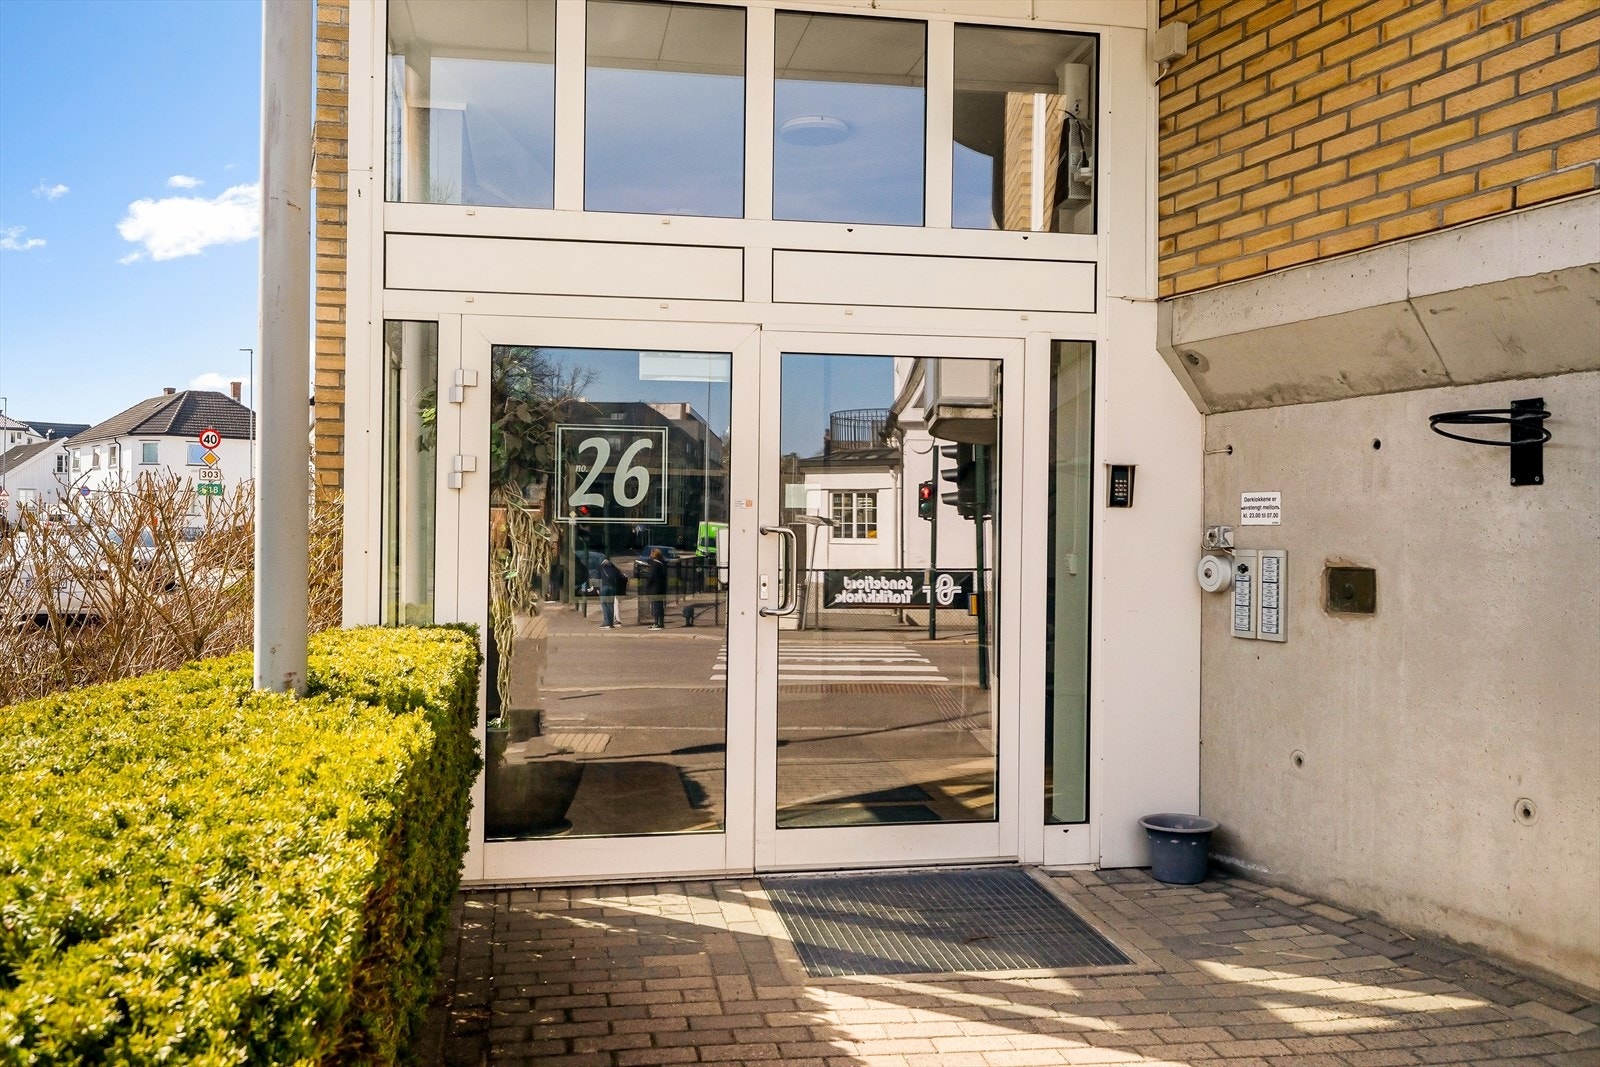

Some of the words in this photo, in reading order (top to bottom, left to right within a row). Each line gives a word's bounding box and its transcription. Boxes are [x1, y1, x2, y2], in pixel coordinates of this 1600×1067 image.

[203, 434, 217, 445] 40
[568, 437, 653, 508] 26
[575, 464, 588, 473] no.
[202, 470, 219, 478] 303
